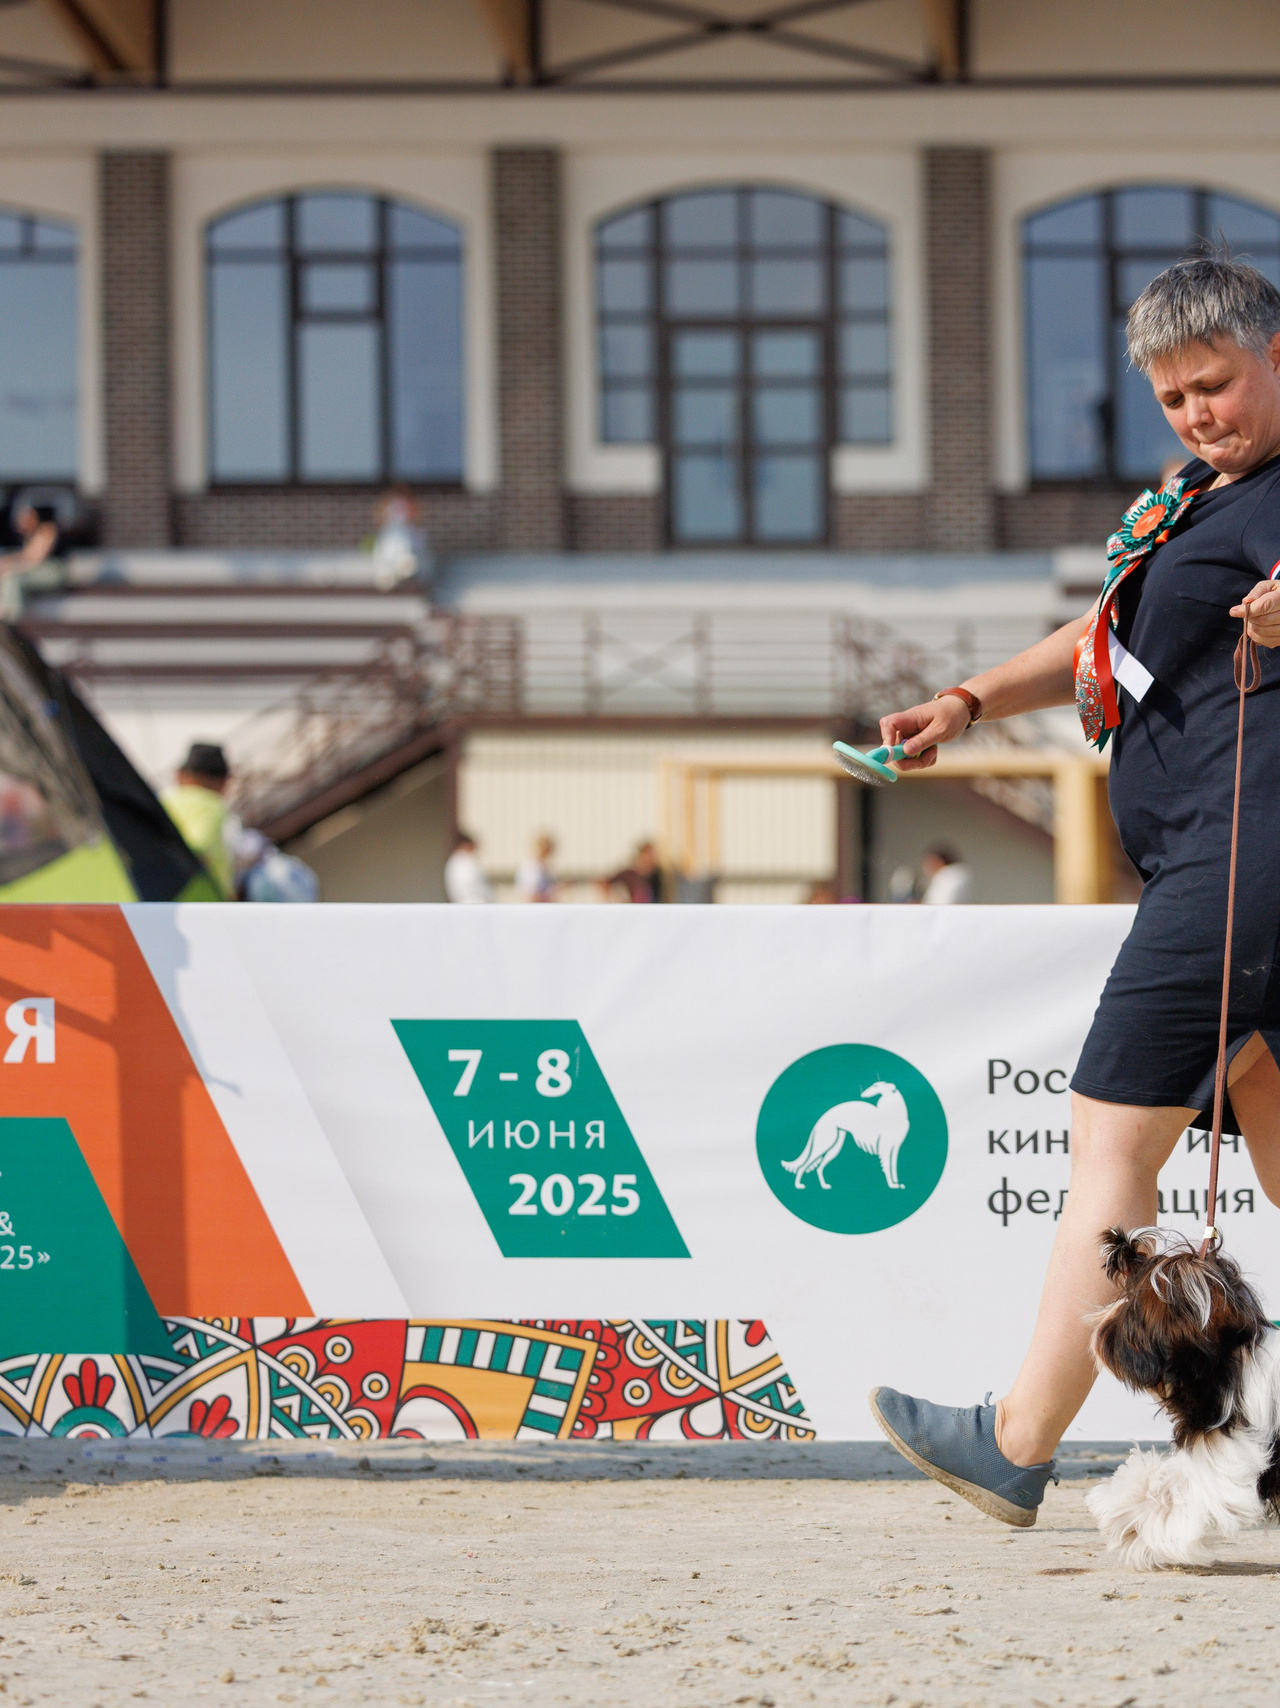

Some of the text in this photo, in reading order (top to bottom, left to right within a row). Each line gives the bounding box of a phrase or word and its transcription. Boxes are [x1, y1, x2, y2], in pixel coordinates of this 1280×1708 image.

[448, 1049, 483, 1097] 7
[535, 1048, 573, 1098] 8
[508, 1173, 641, 1217] 2025
